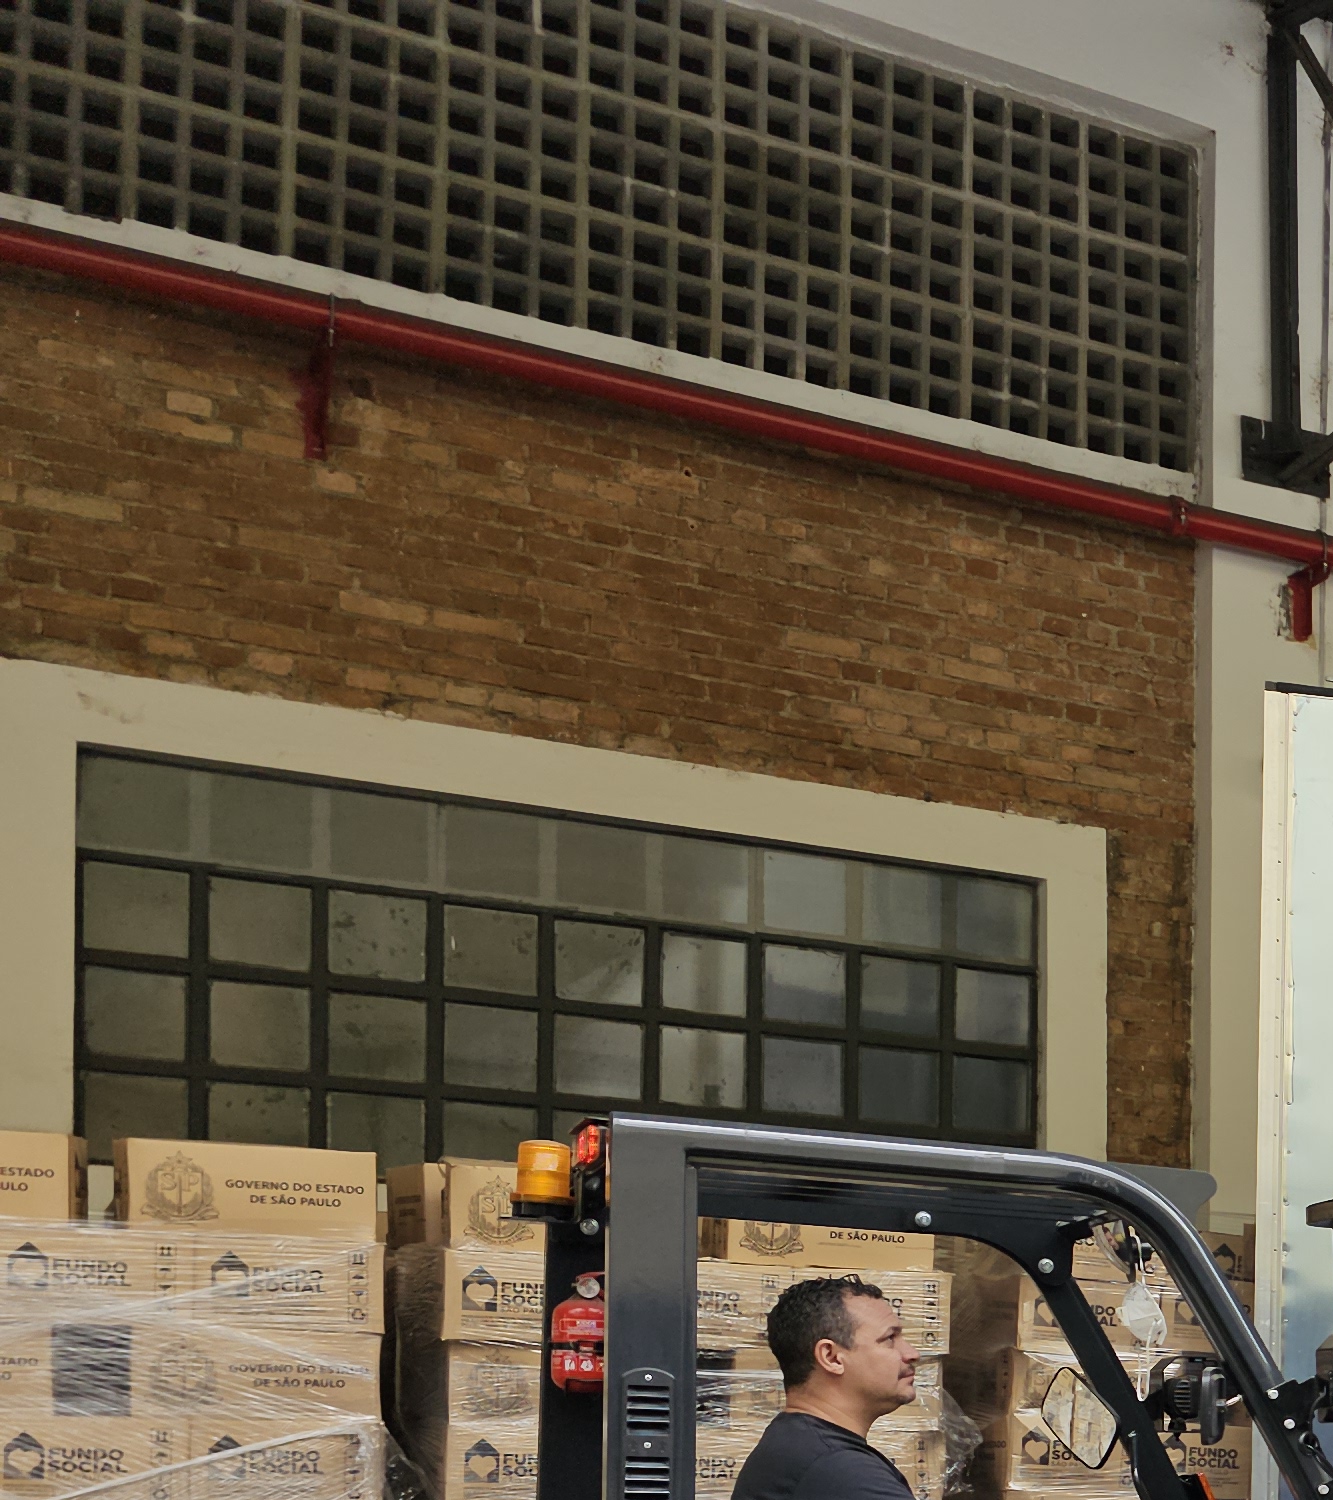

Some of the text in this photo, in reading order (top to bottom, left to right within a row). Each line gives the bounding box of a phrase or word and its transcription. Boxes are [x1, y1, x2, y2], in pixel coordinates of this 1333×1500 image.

[0, 1166, 54, 1178] ESTADO
[226, 1179, 364, 1194] GOVERNO DO ESTADO
[250, 1194, 342, 1208] DE SÃO PAULO
[830, 1230, 904, 1244] DE SÃO PAULO
[53, 1258, 128, 1273] FUNDO
[254, 1378, 346, 1388] DE SÃO PAULO
[48, 1448, 124, 1461] FUNDO
[1189, 1446, 1238, 1460] FUNDO
[48, 1460, 128, 1473] SOCIAL
[1188, 1458, 1240, 1470] SOCIAL
